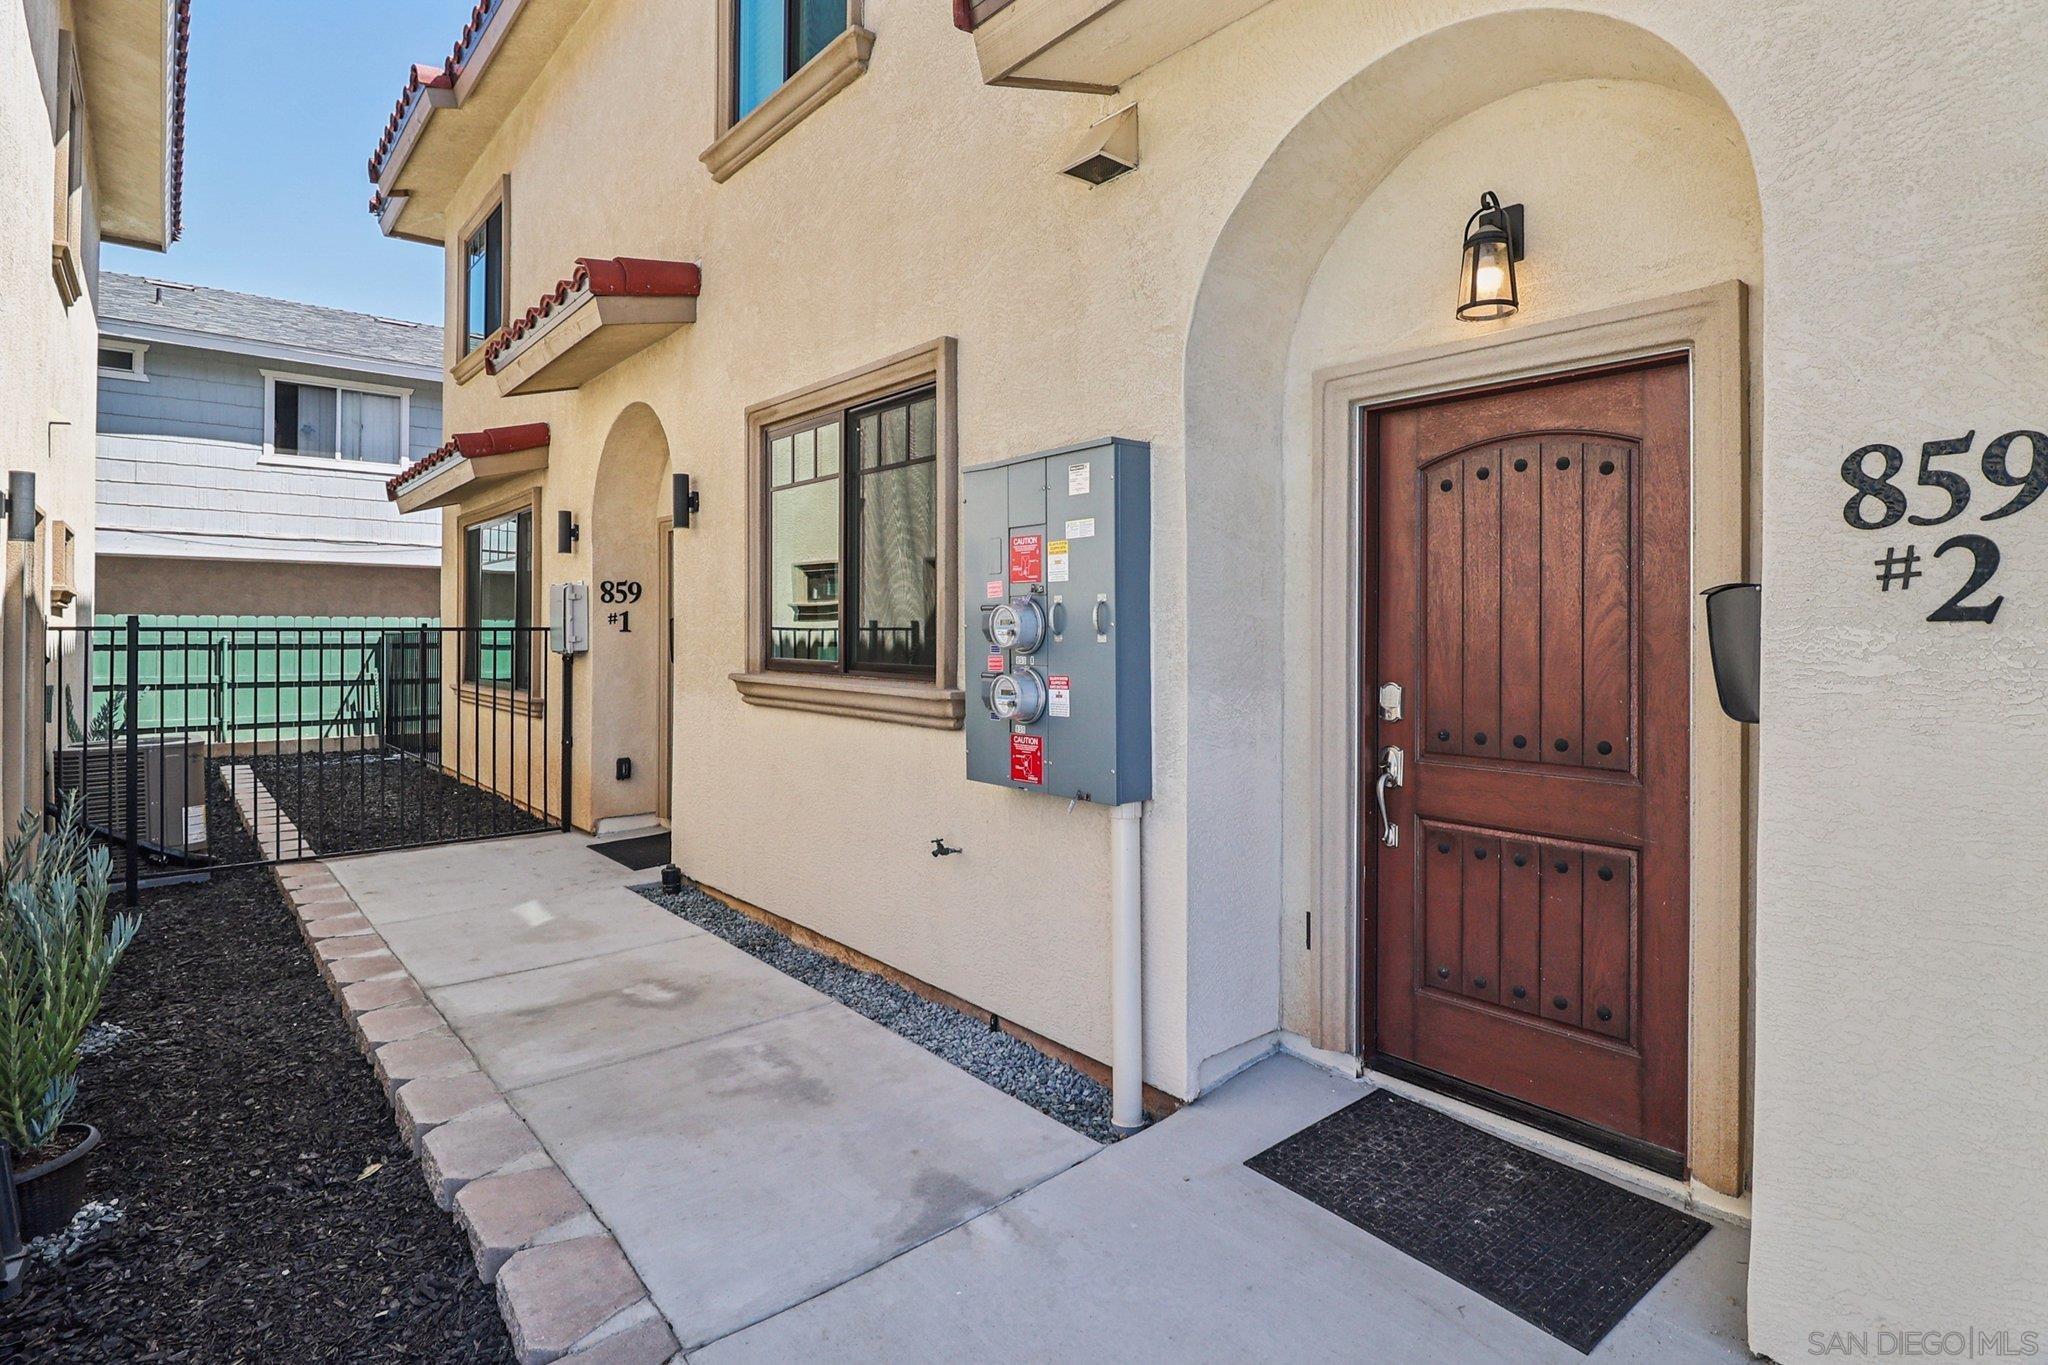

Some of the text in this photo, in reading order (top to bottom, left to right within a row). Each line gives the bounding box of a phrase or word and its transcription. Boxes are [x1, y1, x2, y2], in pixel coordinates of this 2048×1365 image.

[1841, 429, 2048, 530] 859
[1012, 536, 1038, 546] CAUTION
[1874, 533, 2005, 624] #2
[600, 580, 642, 604] 859
[607, 610, 632, 633] #1
[1013, 735, 1039, 746] CAUTION
